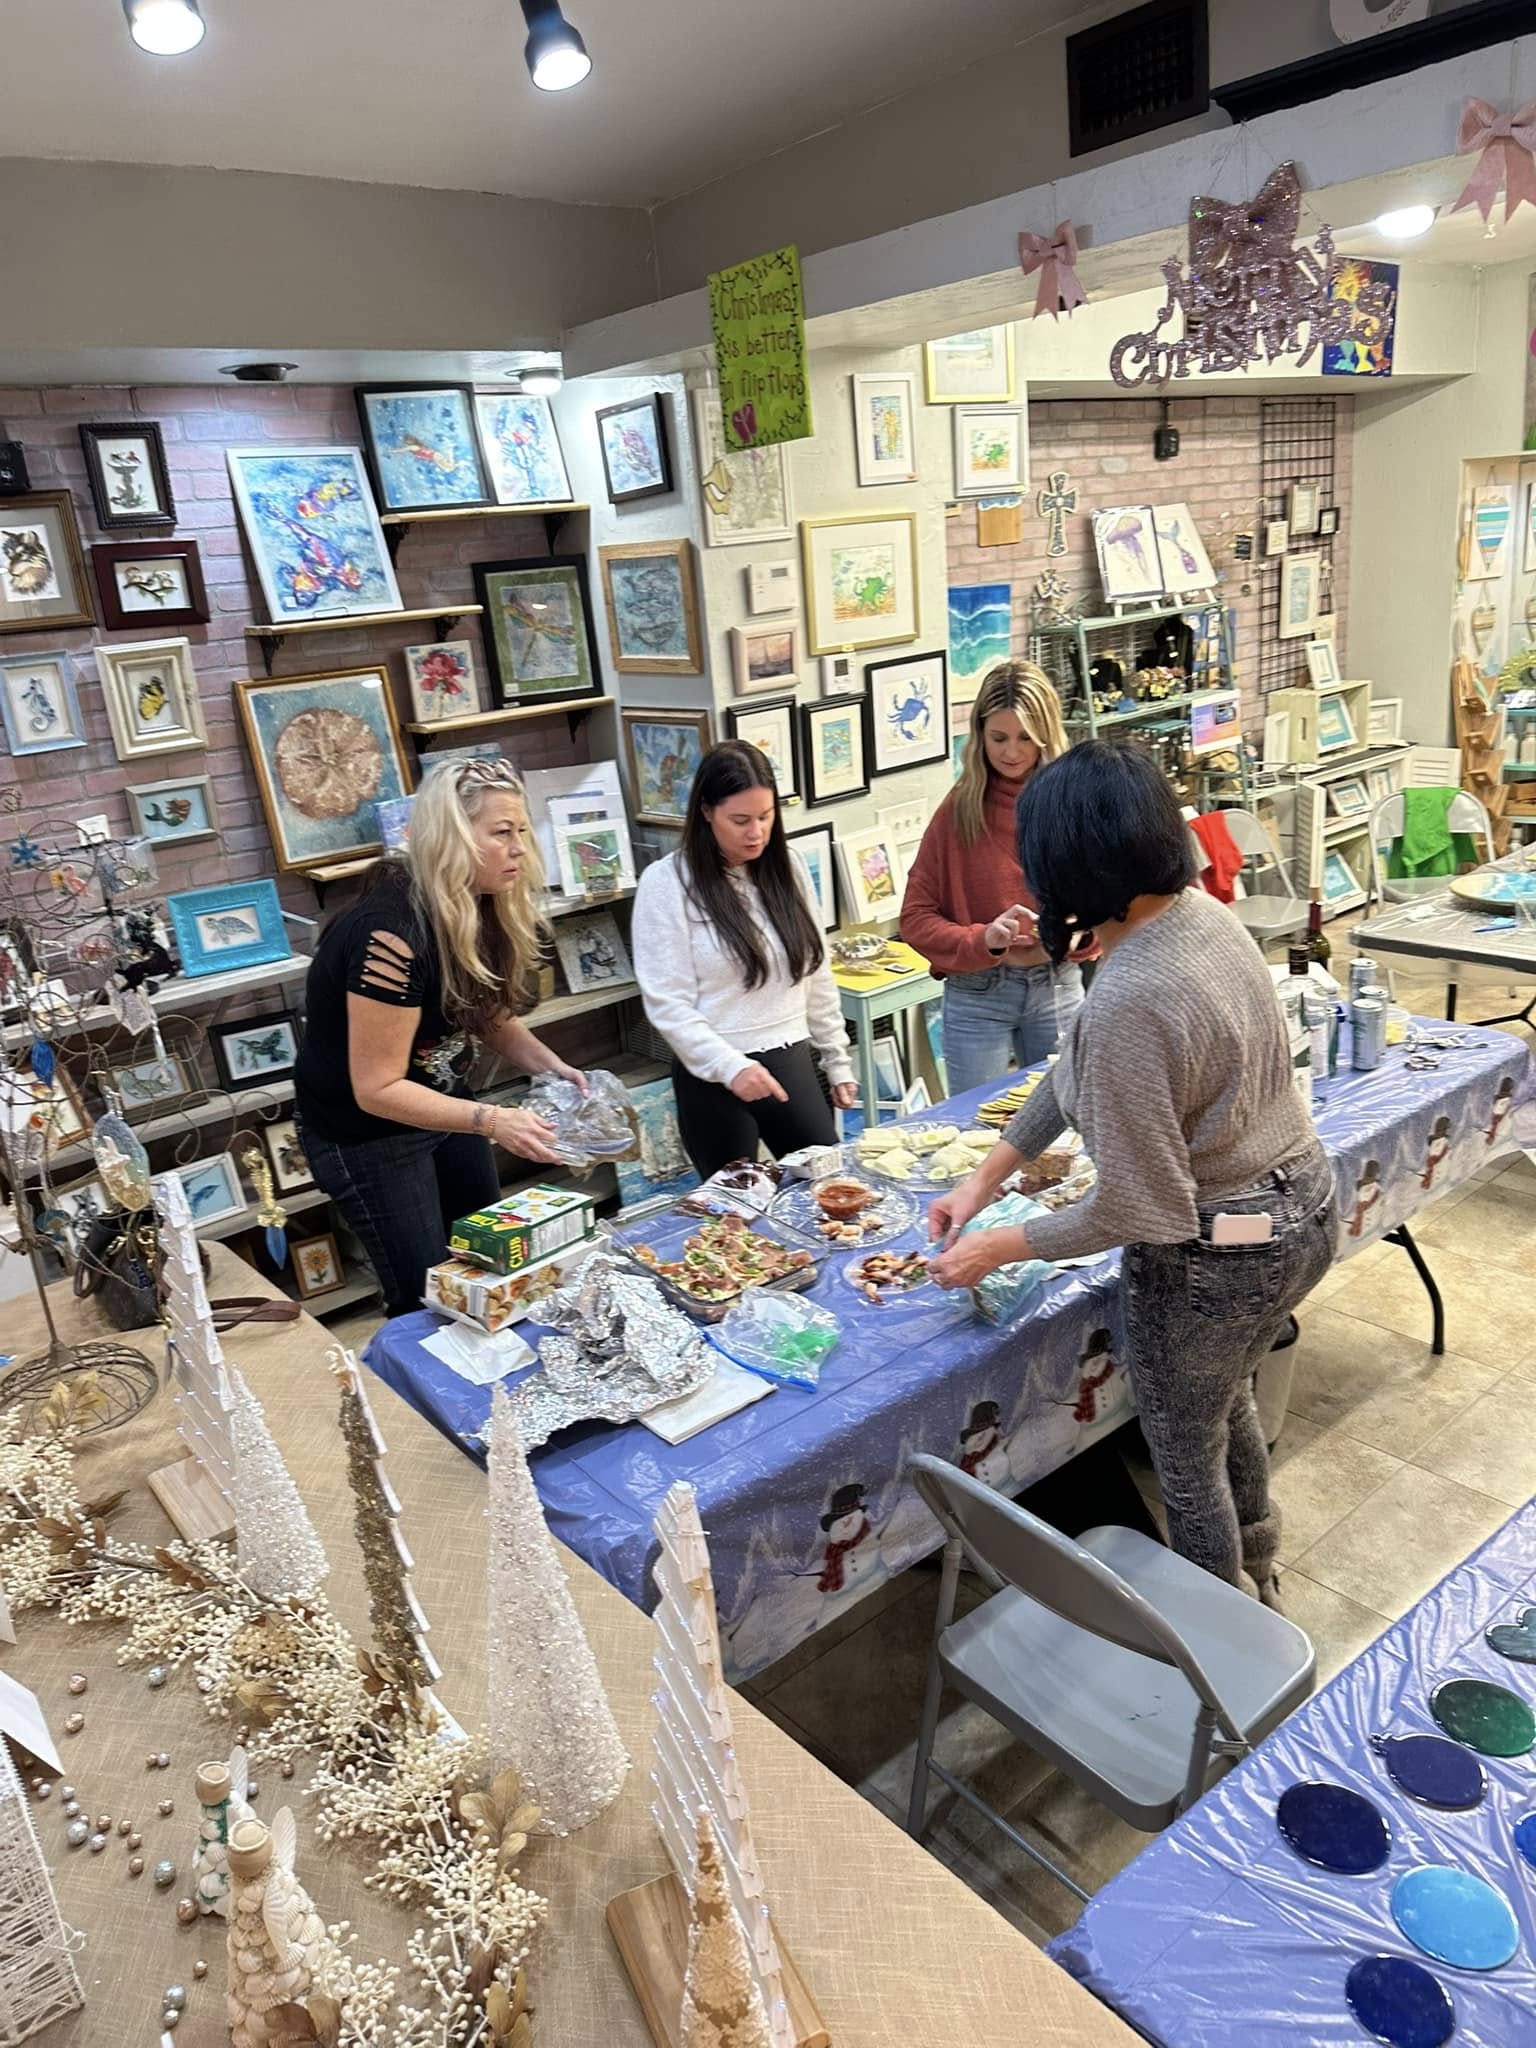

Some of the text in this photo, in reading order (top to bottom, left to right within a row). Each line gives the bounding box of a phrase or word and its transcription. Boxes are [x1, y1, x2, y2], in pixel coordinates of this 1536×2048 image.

[720, 288, 795, 320] Christmas
[725, 327, 796, 358] is better
[741, 370, 766, 404] flip
[767, 366, 805, 400] flops
[509, 1236, 523, 1268] CLUB
